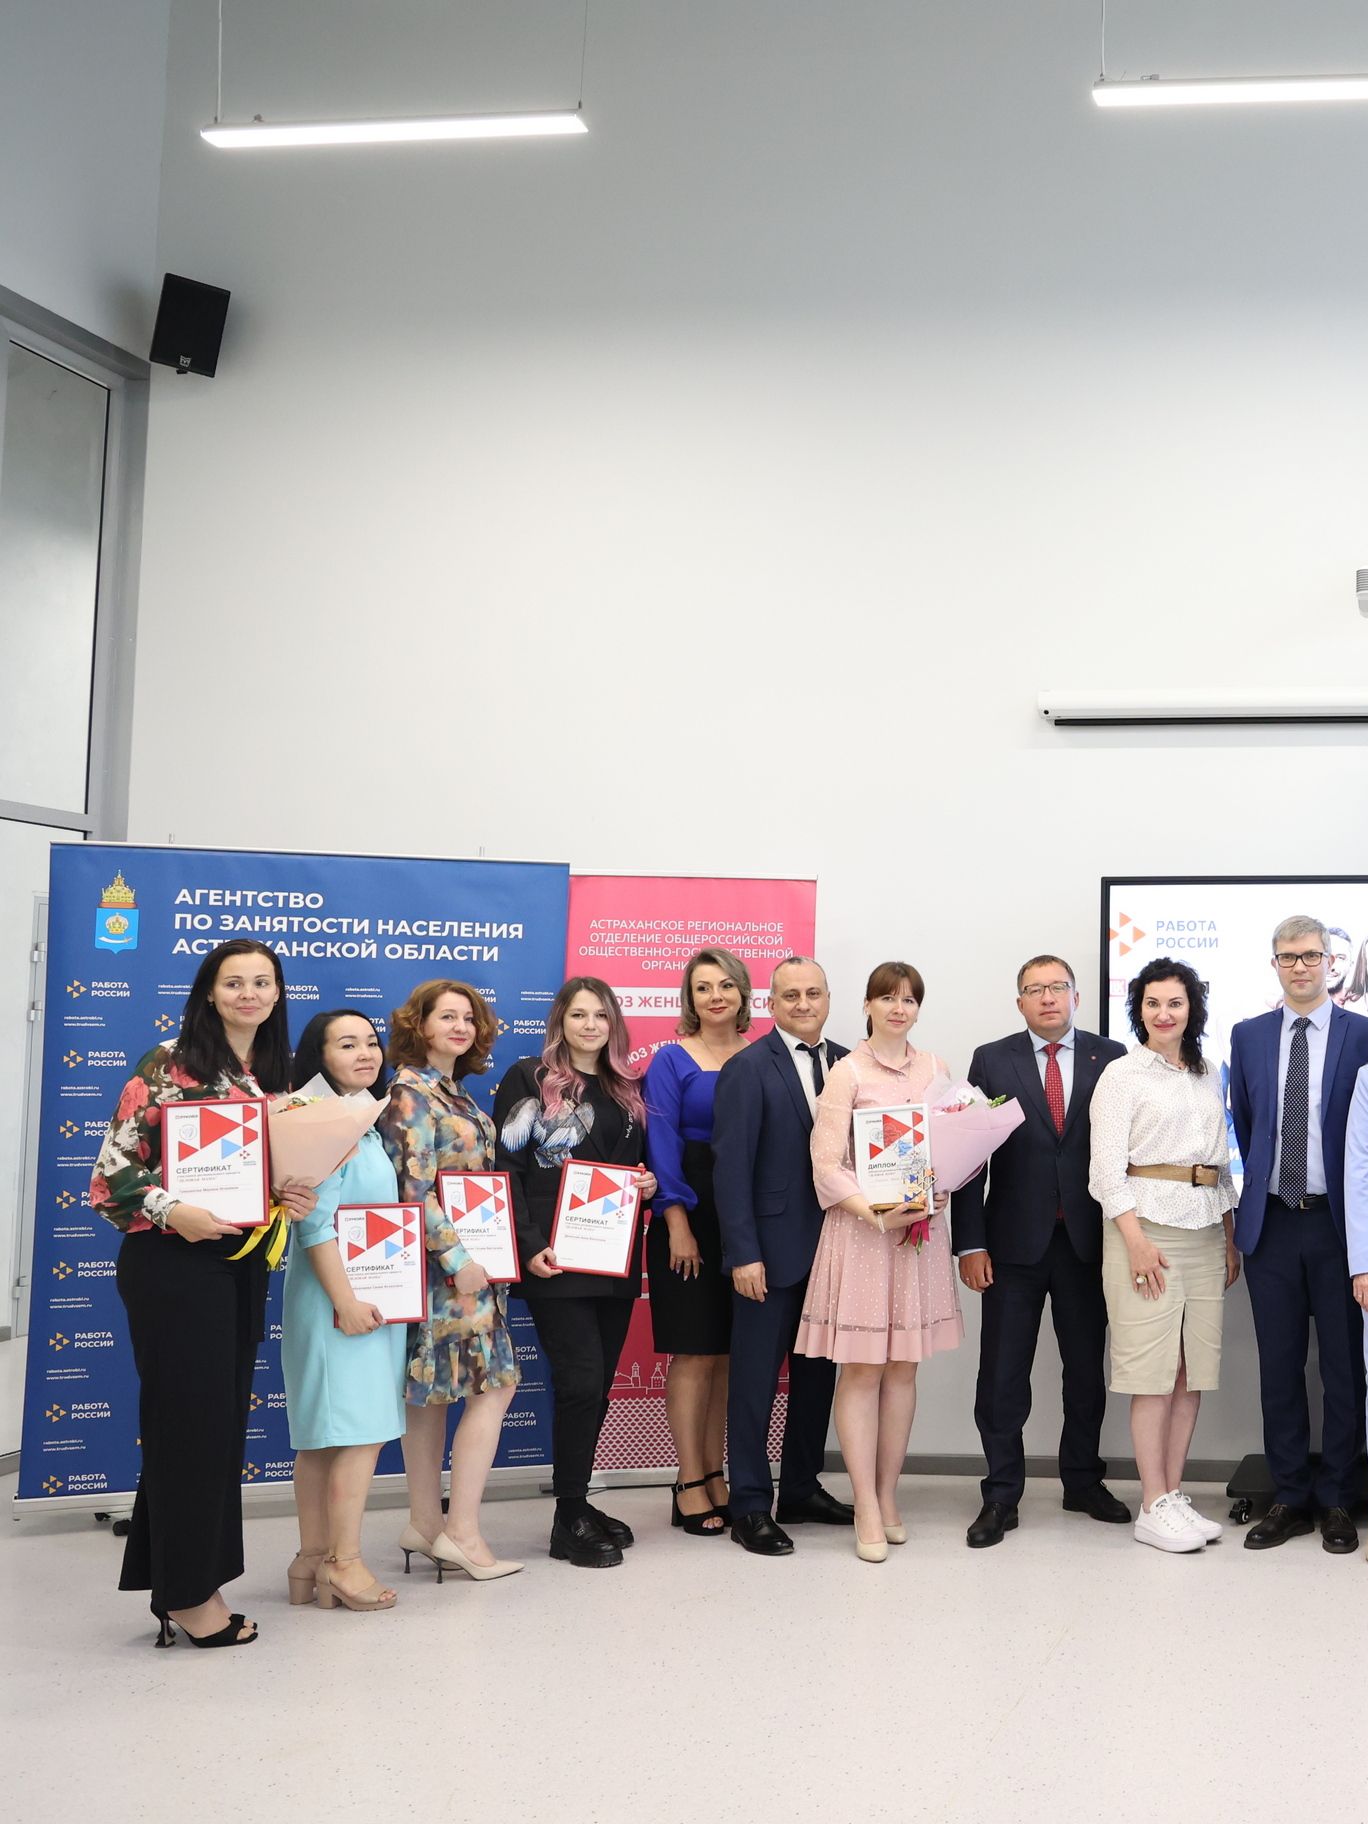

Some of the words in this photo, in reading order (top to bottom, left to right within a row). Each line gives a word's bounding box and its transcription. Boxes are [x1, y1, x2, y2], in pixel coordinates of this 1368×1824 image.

[174, 888, 324, 909] АГЕНТСТВО
[174, 913, 213, 931] ПО
[219, 914, 370, 935] ЗАНЯТОСТИ
[377, 919, 524, 939] НАСЕЛЕНИЯ
[590, 919, 685, 931] АСТРАХАНСКОЕ
[687, 920, 784, 933] РЕГИОНАЛЬНОЕ
[1156, 920, 1217, 932] РАБОТА
[589, 932, 662, 945] ОТДЕЛЕНИЕ
[664, 932, 784, 946] ОБЩЕРОССИЙСКОЙ
[1156, 937, 1219, 949] РОССИИ
[384, 943, 499, 962] ОБЛАСТИ
[641, 960, 687, 971] ОРГАНИ
[91, 981, 130, 989] РАБОТА
[91, 990, 131, 998] РОССИИ
[513, 1019, 546, 1027] РАБОТА
[87, 1059, 127, 1067] РОССИИ
[84, 1121, 111, 1129] РАБО
[176, 1164, 232, 1175] СЕРТИФИКАТ
[868, 1161, 897, 1170] ДИПЛОМ
[565, 1215, 609, 1226] СЕРТИФИКАТ
[78, 1261, 116, 1269] РАБОТА
[346, 1264, 395, 1273] СЕРТИФИКАТ
[77, 1269, 117, 1278] РОССИИ
[74, 1331, 113, 1340] РАБОТА
[74, 1340, 114, 1349] РОССИИ
[71, 1402, 110, 1411] РАБОТА
[71, 1411, 111, 1420] РОССИИ
[502, 1419, 537, 1428] РОССИИ
[265, 1461, 294, 1469] РАБОТ
[68, 1473, 107, 1482] РАБОТА
[68, 1482, 108, 1491] РОССИИ
